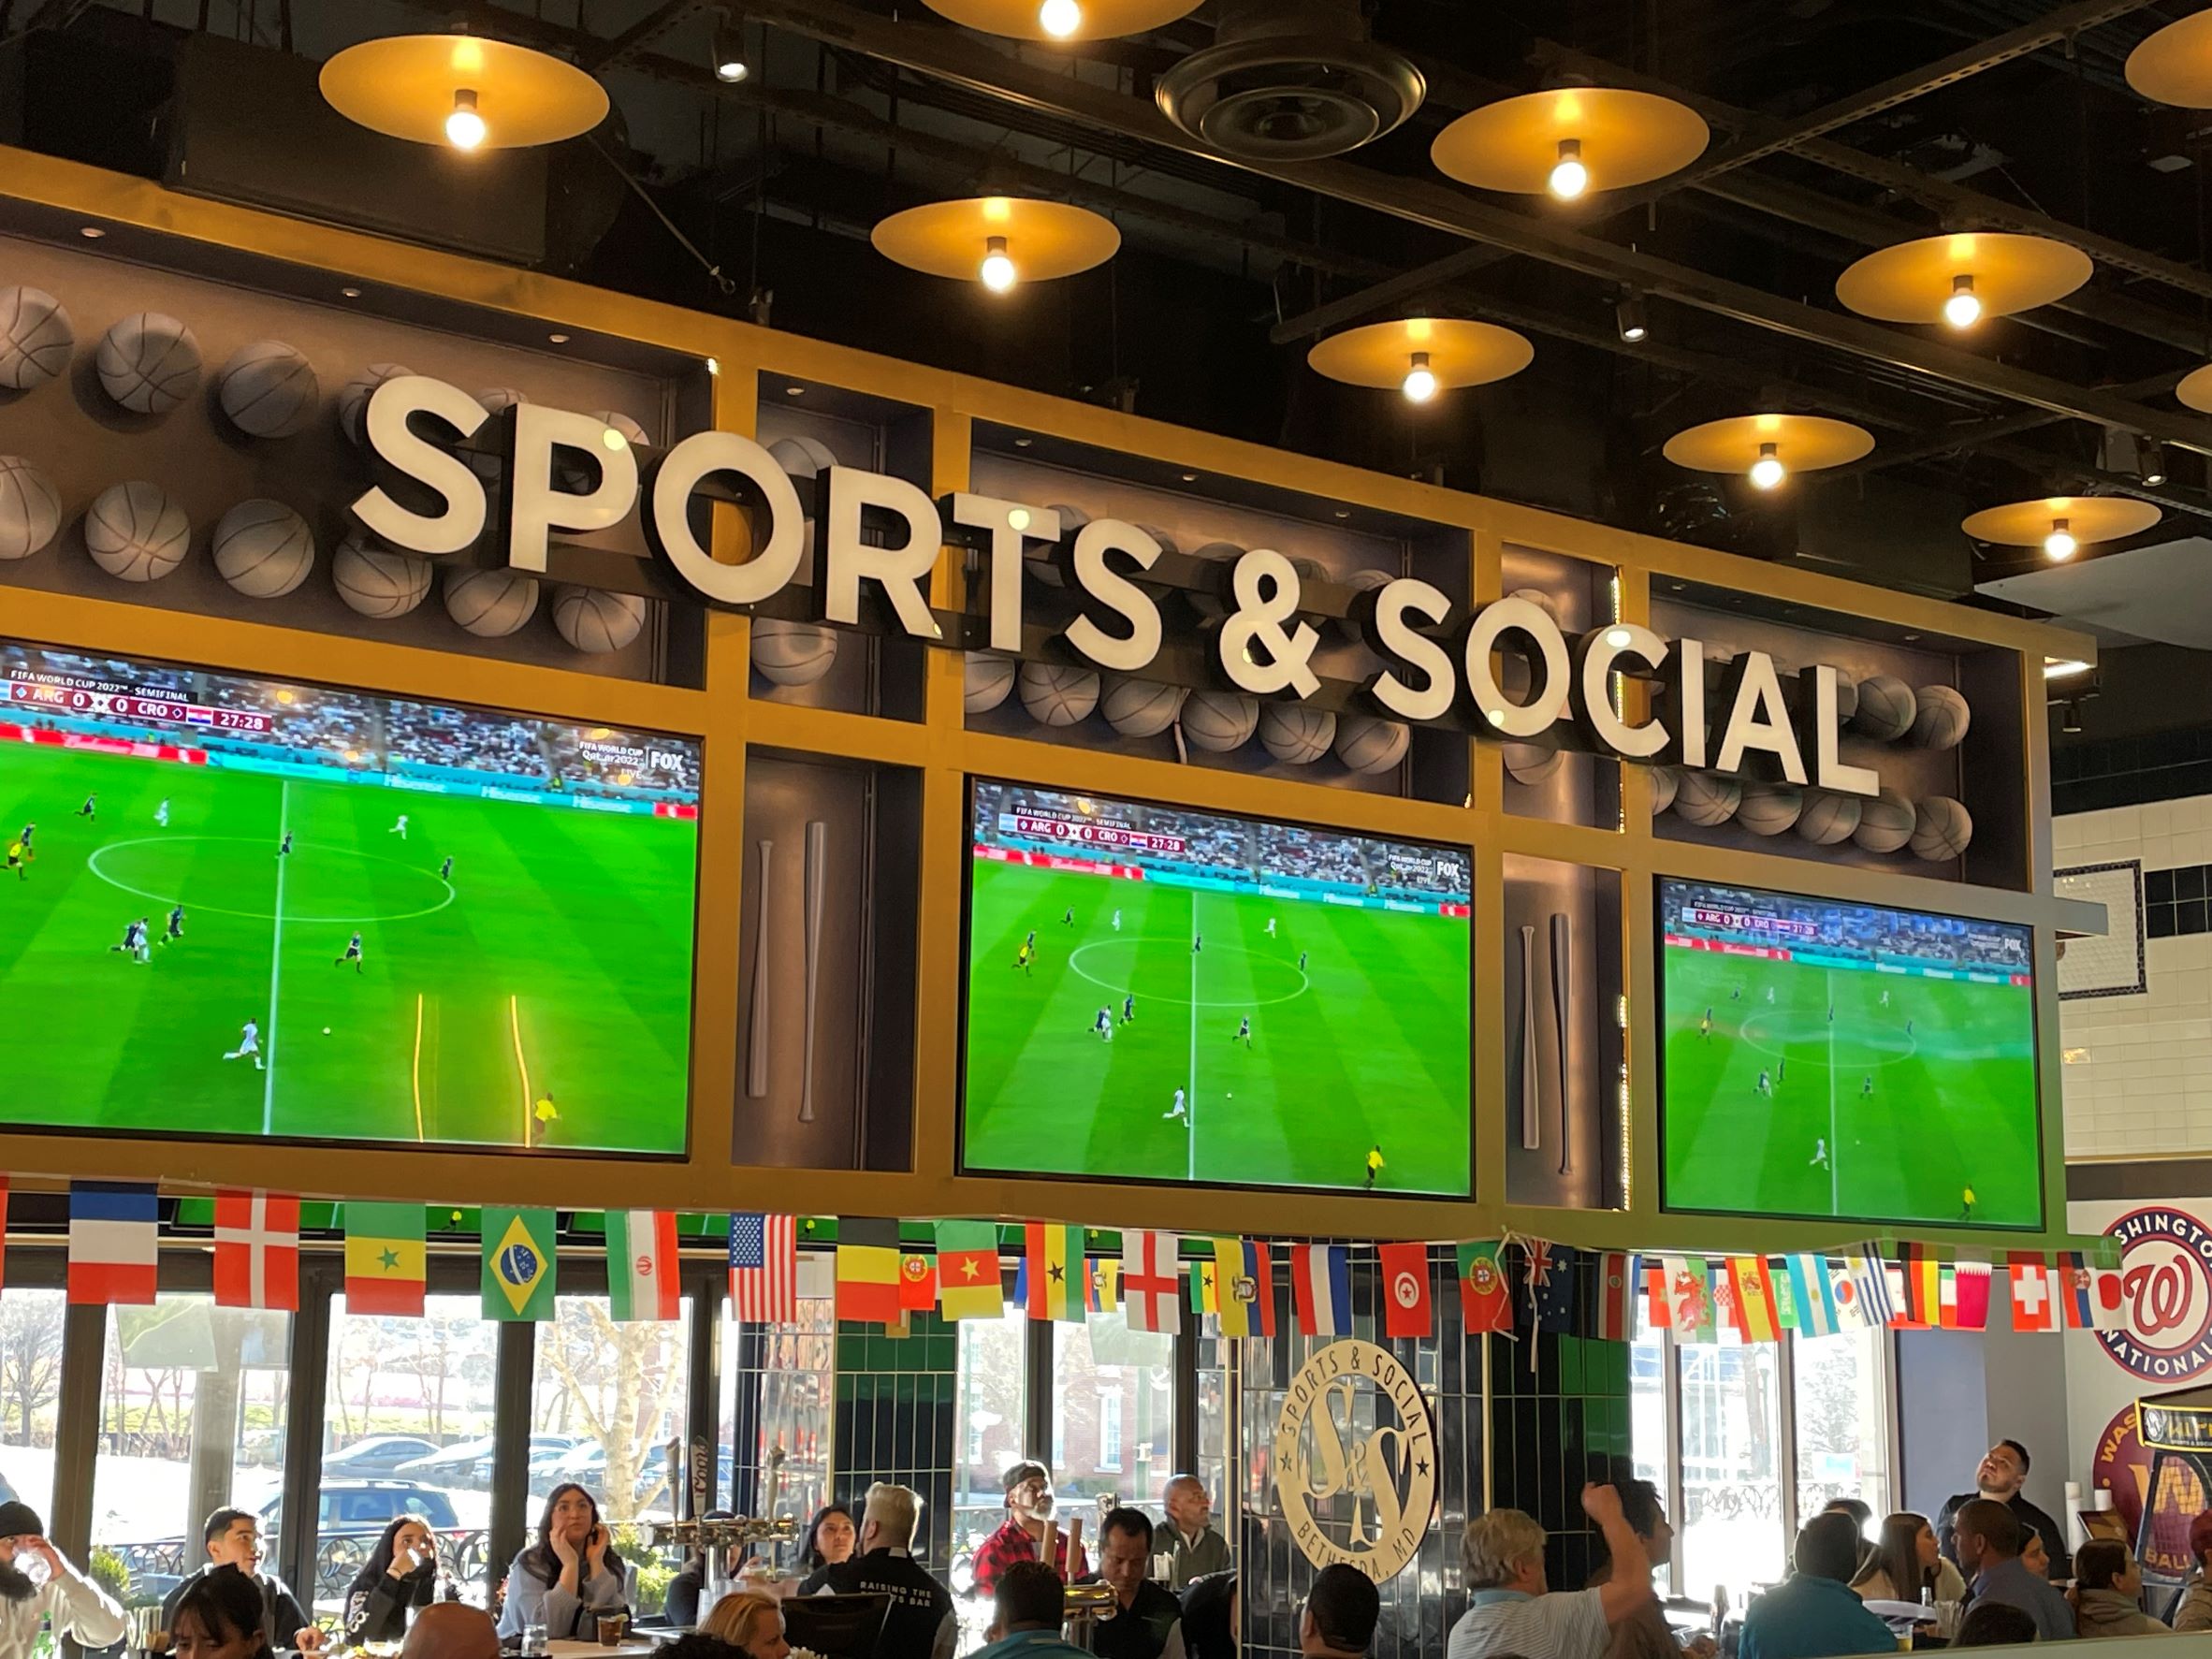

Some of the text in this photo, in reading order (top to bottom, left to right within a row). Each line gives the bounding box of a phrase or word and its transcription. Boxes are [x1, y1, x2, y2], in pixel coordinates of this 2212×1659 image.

[351, 374, 1881, 797] SPORTS & SOCIAL
[10, 670, 36, 681] FIFA
[36, 673, 74, 686] WORLD
[76, 677, 96, 689] CUP
[135, 686, 190, 702] SEMIFINAL
[33, 689, 168, 718] ARG 0 0 CRO
[220, 712, 265, 730] 27:28
[579, 741, 644, 757] FIFA WORLD CUP
[650, 750, 684, 772] FOX
[620, 768, 643, 779] LIVE
[1016, 807, 1032, 817] FIFA
[1033, 809, 1057, 820] WORLD
[1058, 813, 1071, 822] CUP
[1096, 818, 1132, 830] SEMIFINAL
[1030, 821, 1118, 842] ARG 0 0 CRO
[1151, 837, 1181, 851] 27:28
[1436, 861, 1460, 878] FOX
[2004, 938, 2022, 952] FOX
[2103, 1329, 2212, 1375] NATIONAL
[1282, 1346, 1428, 1447] SPORTS & SOCIAL
[859, 1580, 908, 1594] RAISING
[912, 1588, 932, 1598] THE
[909, 1596, 931, 1608] BAR
